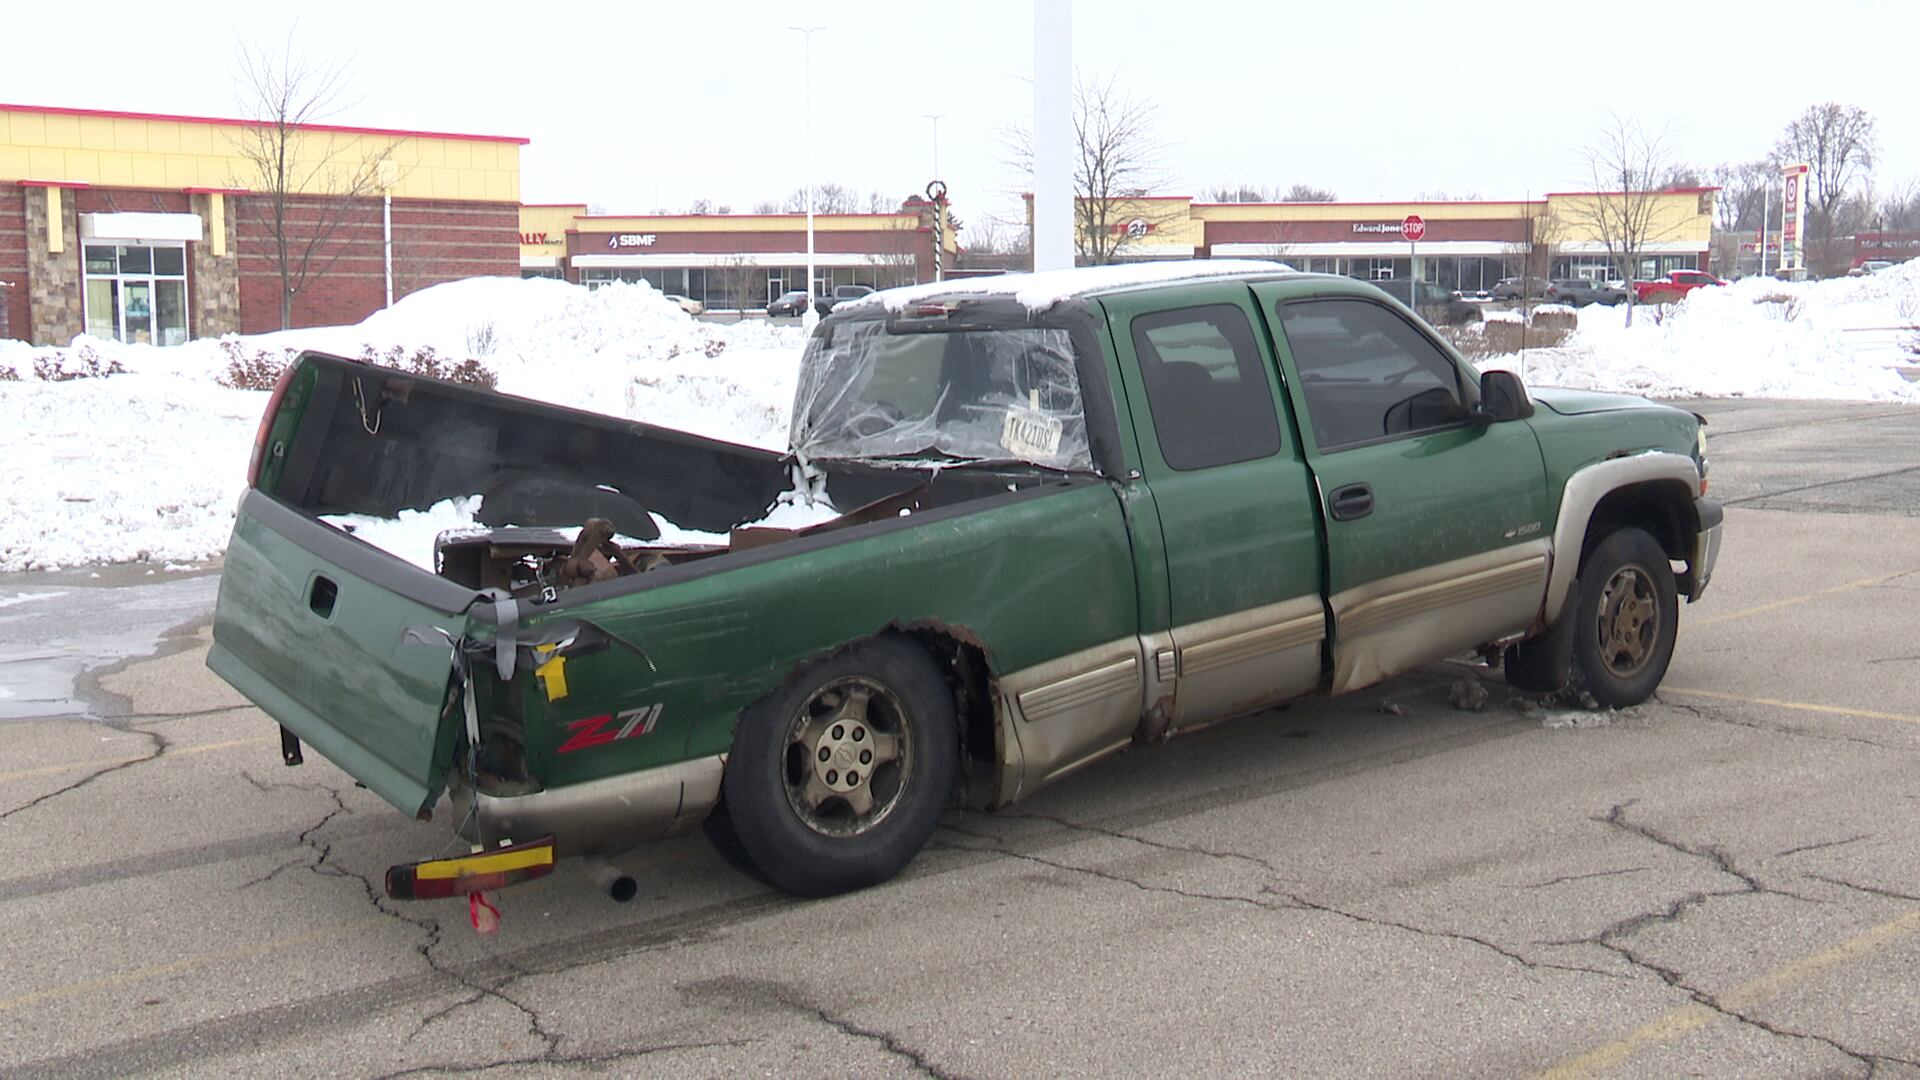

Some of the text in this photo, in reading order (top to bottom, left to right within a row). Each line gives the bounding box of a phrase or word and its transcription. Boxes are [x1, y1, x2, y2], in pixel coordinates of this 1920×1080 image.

[1352, 223, 1402, 234] Edward Jone
[1403, 222, 1424, 234] STOP
[620, 234, 656, 246] SBMF
[1517, 521, 1542, 536] 1500
[557, 703, 664, 753] Z71
